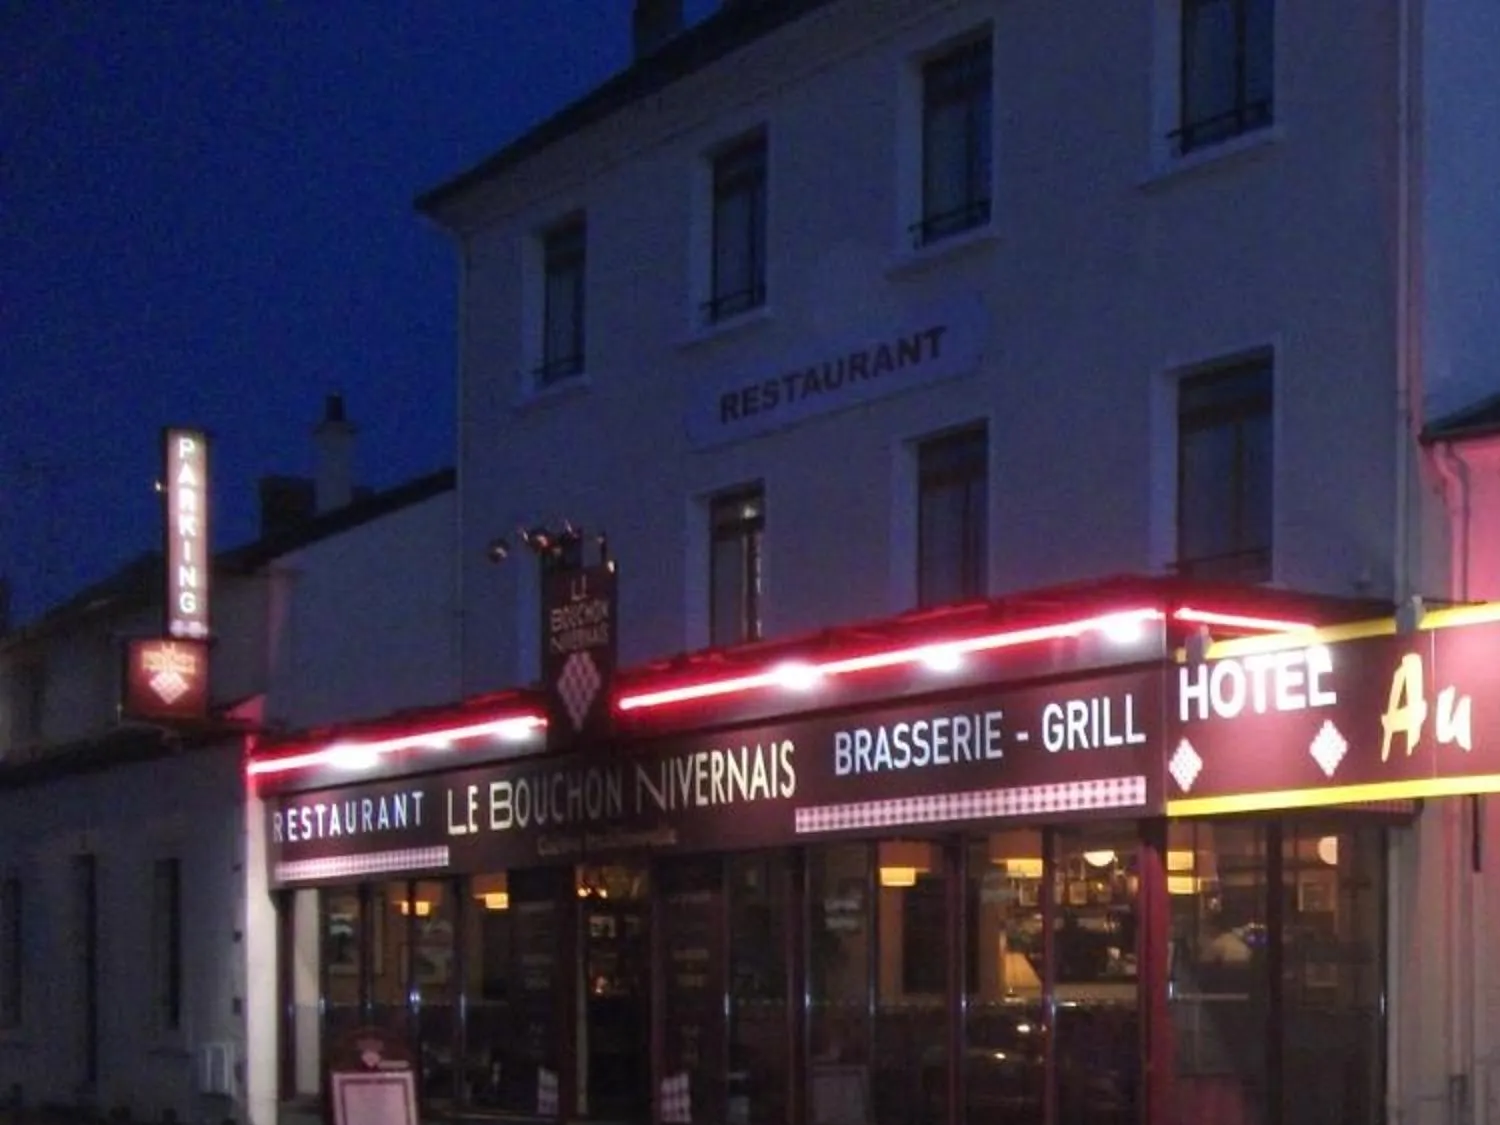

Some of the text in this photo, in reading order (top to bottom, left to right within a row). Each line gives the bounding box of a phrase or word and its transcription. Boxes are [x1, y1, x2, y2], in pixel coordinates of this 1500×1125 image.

[718, 325, 947, 424] RESTAURANT
[177, 436, 199, 615] PARKING
[1178, 644, 1337, 721] HOTEL
[1380, 652, 1472, 763] Au
[833, 710, 1003, 775] BRASSERIE
[1041, 693, 1146, 751] GRILL
[272, 790, 425, 843] RESTAURANT
[446, 739, 797, 836] LE BOUCHON NIVERNAIS
